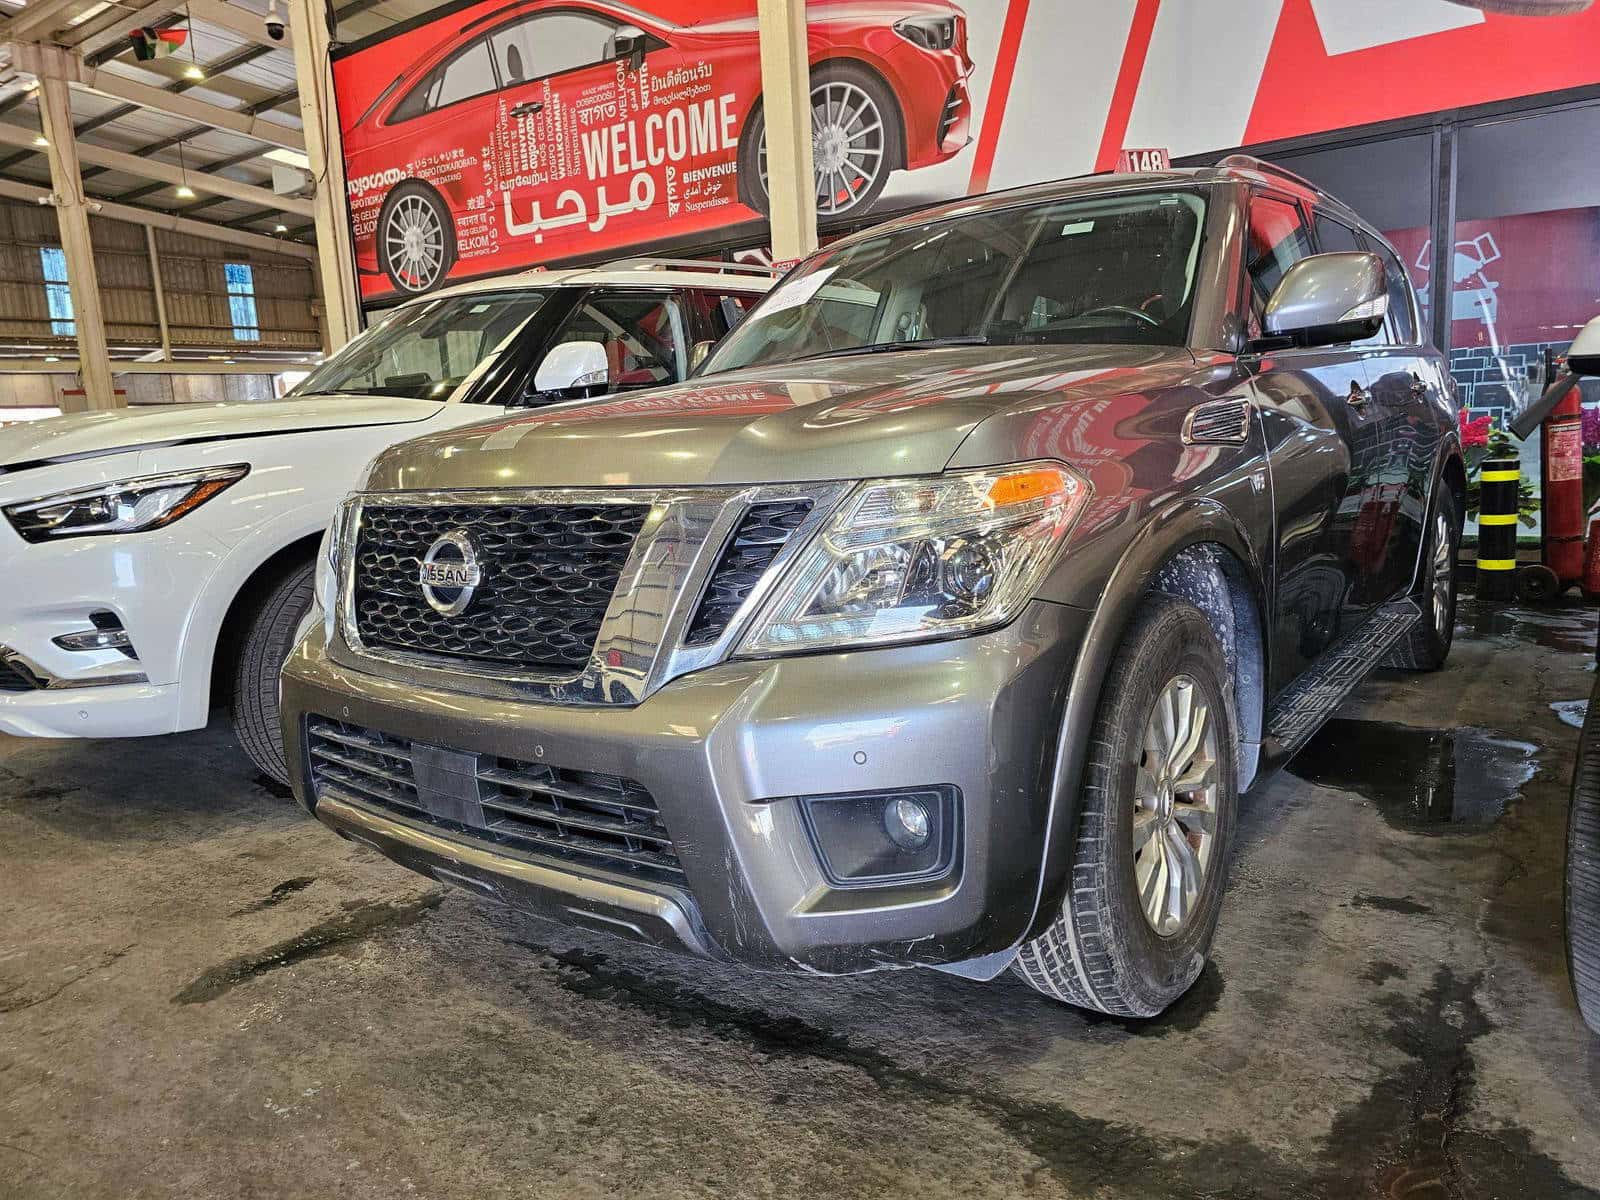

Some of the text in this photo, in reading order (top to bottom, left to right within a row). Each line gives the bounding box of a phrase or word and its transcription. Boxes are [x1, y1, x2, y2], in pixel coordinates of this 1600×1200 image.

[615, 60, 628, 122] WELKOM
[552, 93, 565, 180] WILLKOMMEN
[570, 107, 581, 175] Suspendisse
[580, 93, 739, 181] WELCOME
[1131, 151, 1163, 173] 148
[682, 161, 738, 184] BIENVENUE
[502, 172, 656, 244] مرحبا
[685, 196, 729, 213] Suspendisse
[422, 568, 467, 582] NISSAN
